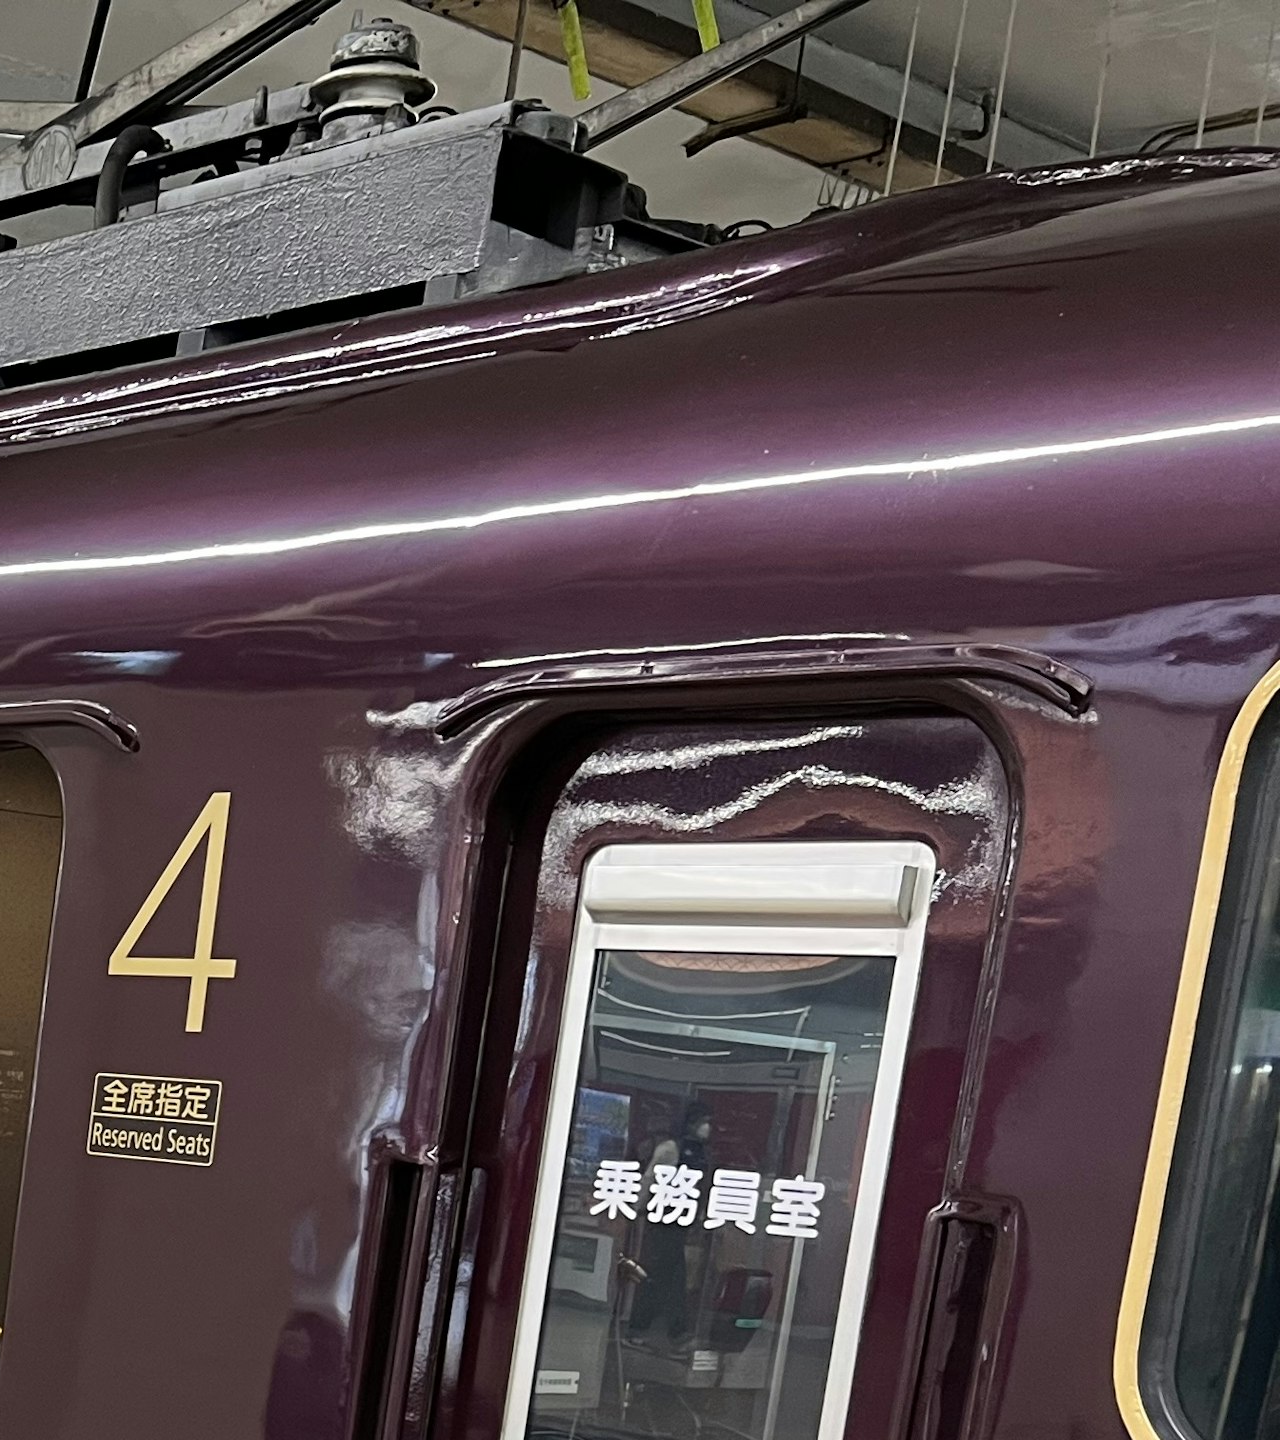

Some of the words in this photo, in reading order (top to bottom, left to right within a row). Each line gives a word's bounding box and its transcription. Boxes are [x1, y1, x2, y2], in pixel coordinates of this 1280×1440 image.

[108, 792, 236, 1032] 4
[101, 1079, 211, 1119] 全席指定
[92, 1122, 164, 1152] Reserved
[166, 1128, 211, 1157] Seats
[590, 1160, 825, 1239] 乗務員室
